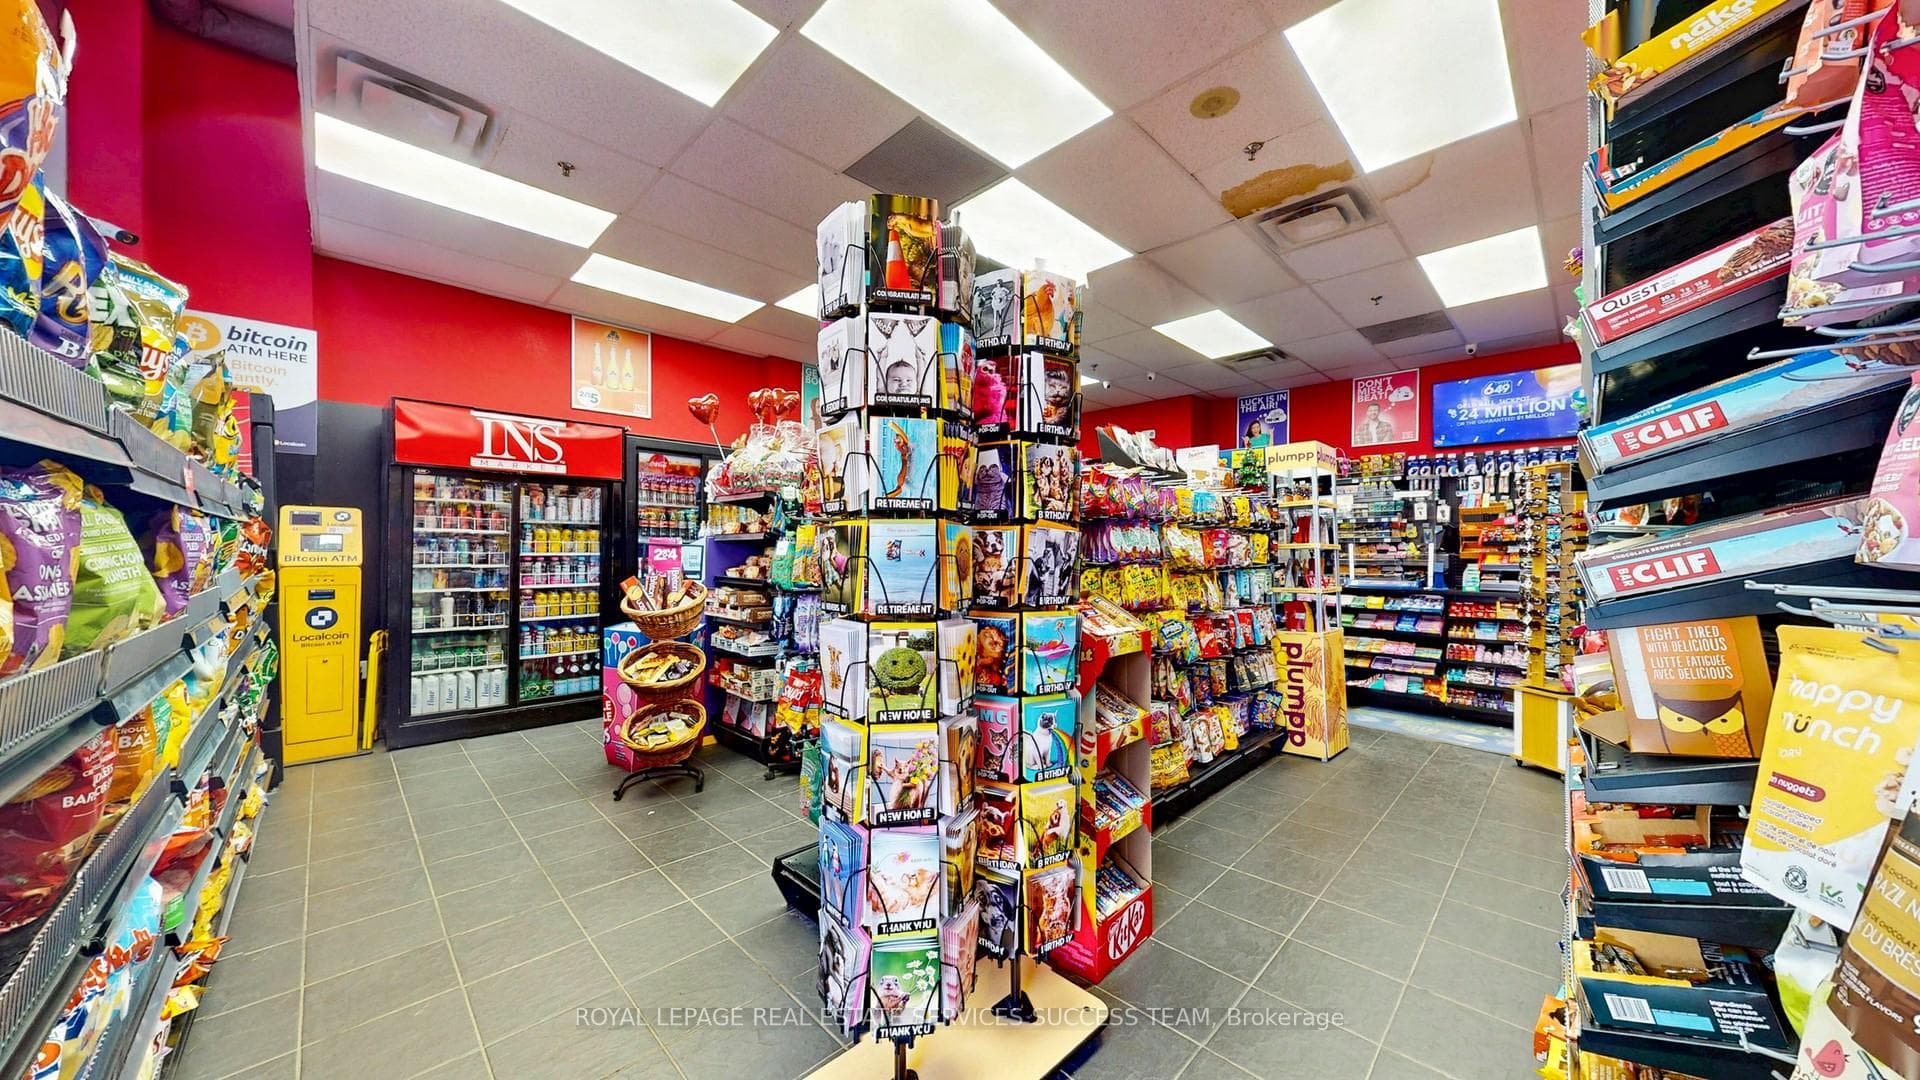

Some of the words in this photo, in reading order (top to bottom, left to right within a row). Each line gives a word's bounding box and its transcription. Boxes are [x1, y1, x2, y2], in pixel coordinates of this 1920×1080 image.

[1602, 282, 1660, 313] QUEST
[227, 325, 308, 352] bitcoin
[976, 335, 1009, 348] IRTHDY
[1038, 336, 1072, 351] BRTHDY
[227, 343, 263, 357] ATM
[267, 349, 308, 364] HERE
[231, 360, 288, 377] Bitcoin
[1358, 376, 1393, 390] DON'T
[1358, 386, 1383, 397] MISS
[1385, 384, 1394, 392] A
[1240, 396, 1263, 407] LUCK
[1266, 395, 1275, 404] IS
[1276, 393, 1287, 402] IN
[1485, 397, 1566, 418] MILLION
[1240, 404, 1258, 414] THE
[1525, 411, 1556, 420] MILLION
[1622, 431, 1641, 451] BAR
[1638, 407, 1716, 445] CLIF
[475, 417, 567, 464] INS
[480, 459, 561, 472] MARKET
[1268, 452, 1315, 465] plumpp
[1038, 510, 1071, 520] BRTHDAY
[284, 555, 328, 563] Bitcoin
[331, 555, 358, 563] ATM
[1618, 567, 1634, 587] BAR
[1632, 552, 1709, 583] CLIF
[877, 604, 932, 614] RETIREMENT
[292, 631, 350, 642] Localcoin
[1644, 627, 1680, 641] FIGHT
[1686, 625, 1720, 639] TIRED
[1647, 641, 1669, 653] WITH
[1672, 637, 1728, 652] DELICIOUS
[1650, 655, 1683, 668] LUTTE
[1653, 669, 1675, 680] AVEC
[1678, 665, 1734, 680] DELICIOUS
[1281, 642, 1314, 748] plumpp
[1788, 673, 1904, 724] happy
[880, 711, 902, 721] NEW
[980, 709, 1008, 724] MG
[1037, 766, 1071, 781] BRTHDY
[1778, 780, 1817, 797] nuggets
[880, 811, 902, 822] NEW
[1818, 845, 1837, 858] noix
[1037, 851, 1071, 868] BRTHDY
[1817, 855, 1837, 869] doré
[1861, 921, 1883, 945] DU
[978, 935, 1005, 954] THDAY
[1041, 933, 1073, 954] IRTHDY
